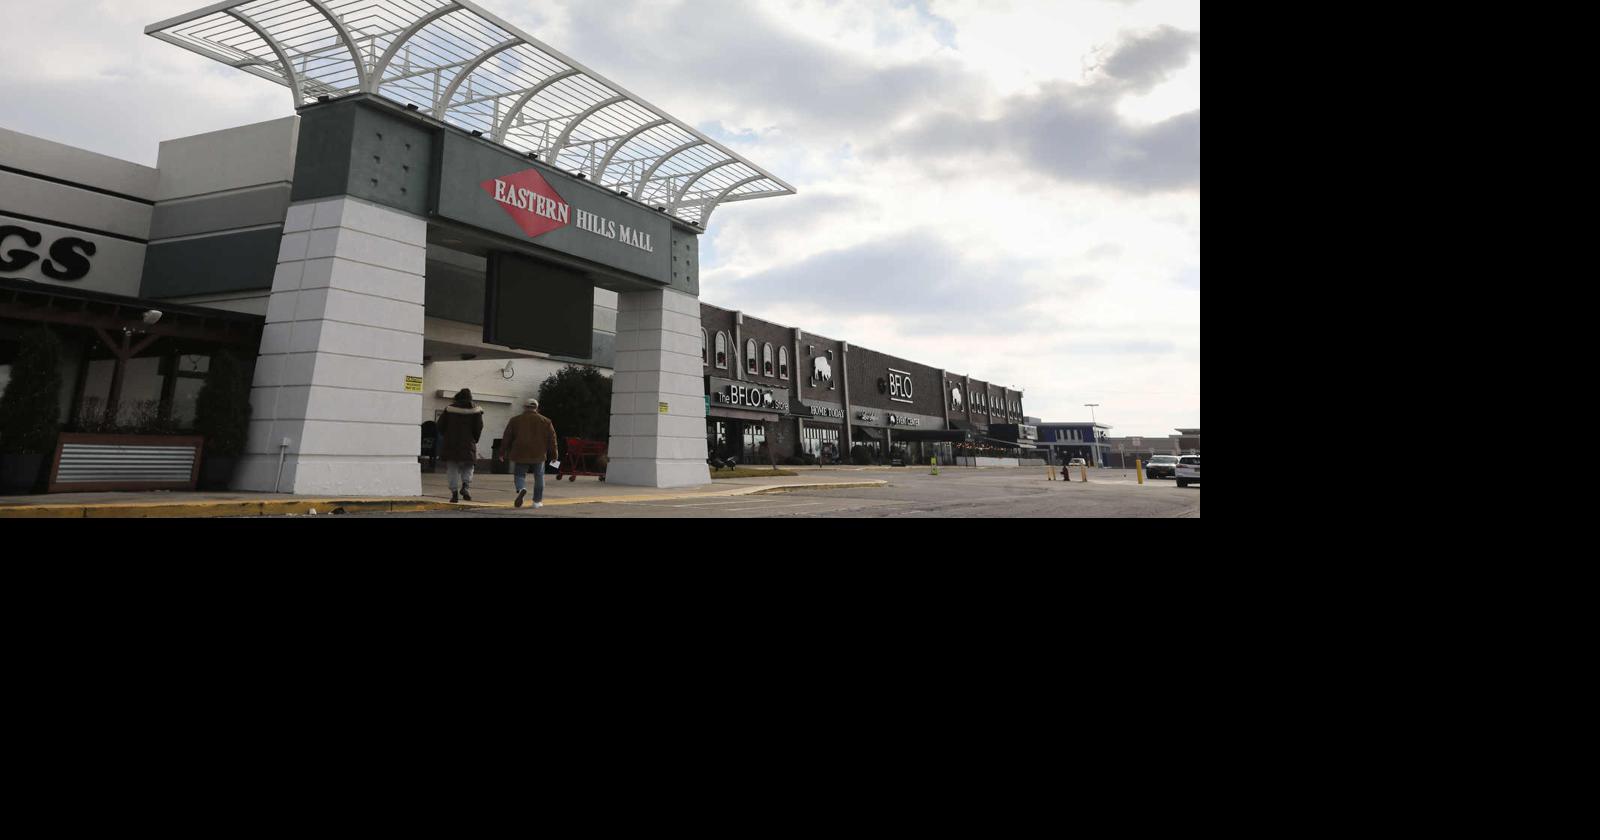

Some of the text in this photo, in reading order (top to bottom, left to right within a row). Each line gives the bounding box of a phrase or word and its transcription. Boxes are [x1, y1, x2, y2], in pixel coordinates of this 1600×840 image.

[494, 179, 653, 252] EASTERN HILLS MALL
[718, 385, 789, 411] The BFLO Store
[889, 373, 913, 399] BFLO
[810, 405, 845, 418] HOME TODAY
